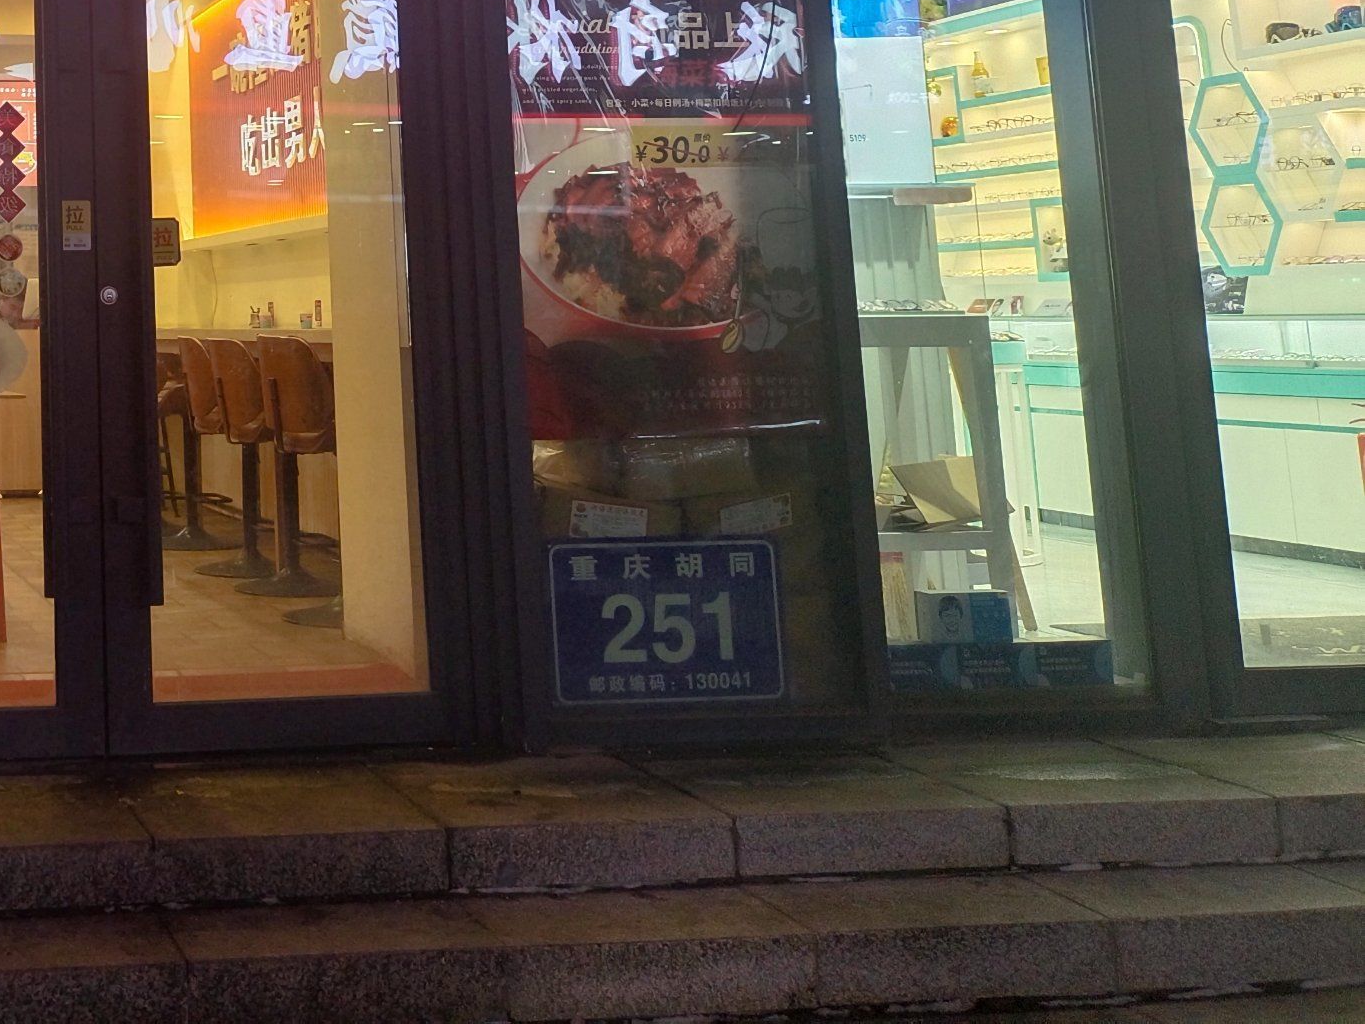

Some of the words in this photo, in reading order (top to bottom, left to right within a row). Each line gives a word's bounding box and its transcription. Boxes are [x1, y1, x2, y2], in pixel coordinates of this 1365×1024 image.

[66, 205, 85, 224] 拉
[154, 228, 174, 248] 拉
[568, 552, 756, 581] 重庆胡同
[600, 591, 734, 664] 251
[686, 672, 752, 691] 130041
